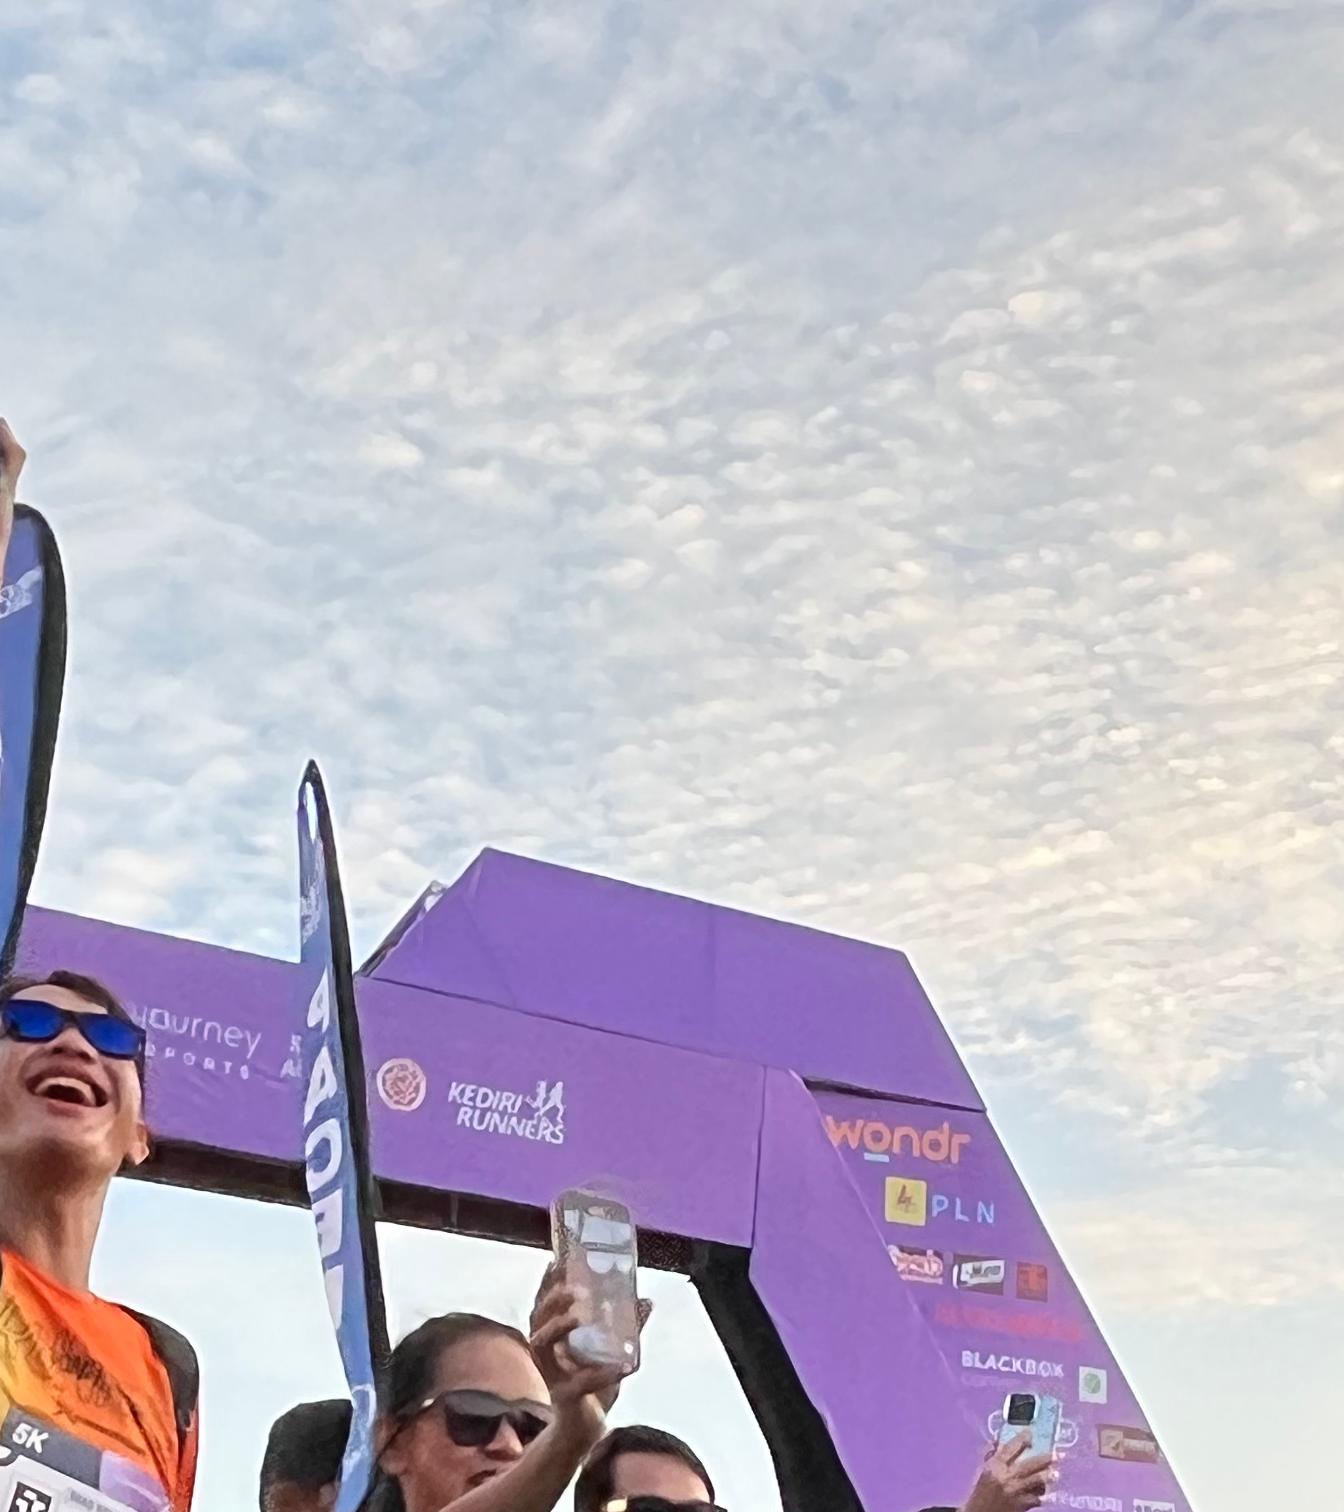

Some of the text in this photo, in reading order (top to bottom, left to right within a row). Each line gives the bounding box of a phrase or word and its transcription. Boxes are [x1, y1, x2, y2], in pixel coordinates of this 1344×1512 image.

[448, 1081, 524, 1114] KEDIRI
[457, 1106, 564, 1145] RUNNERS
[827, 1114, 972, 1165] wondr
[931, 1194, 995, 1225] PLN
[961, 1350, 1065, 1378] BLACKBOX
[11, 1422, 50, 1453] 5K
